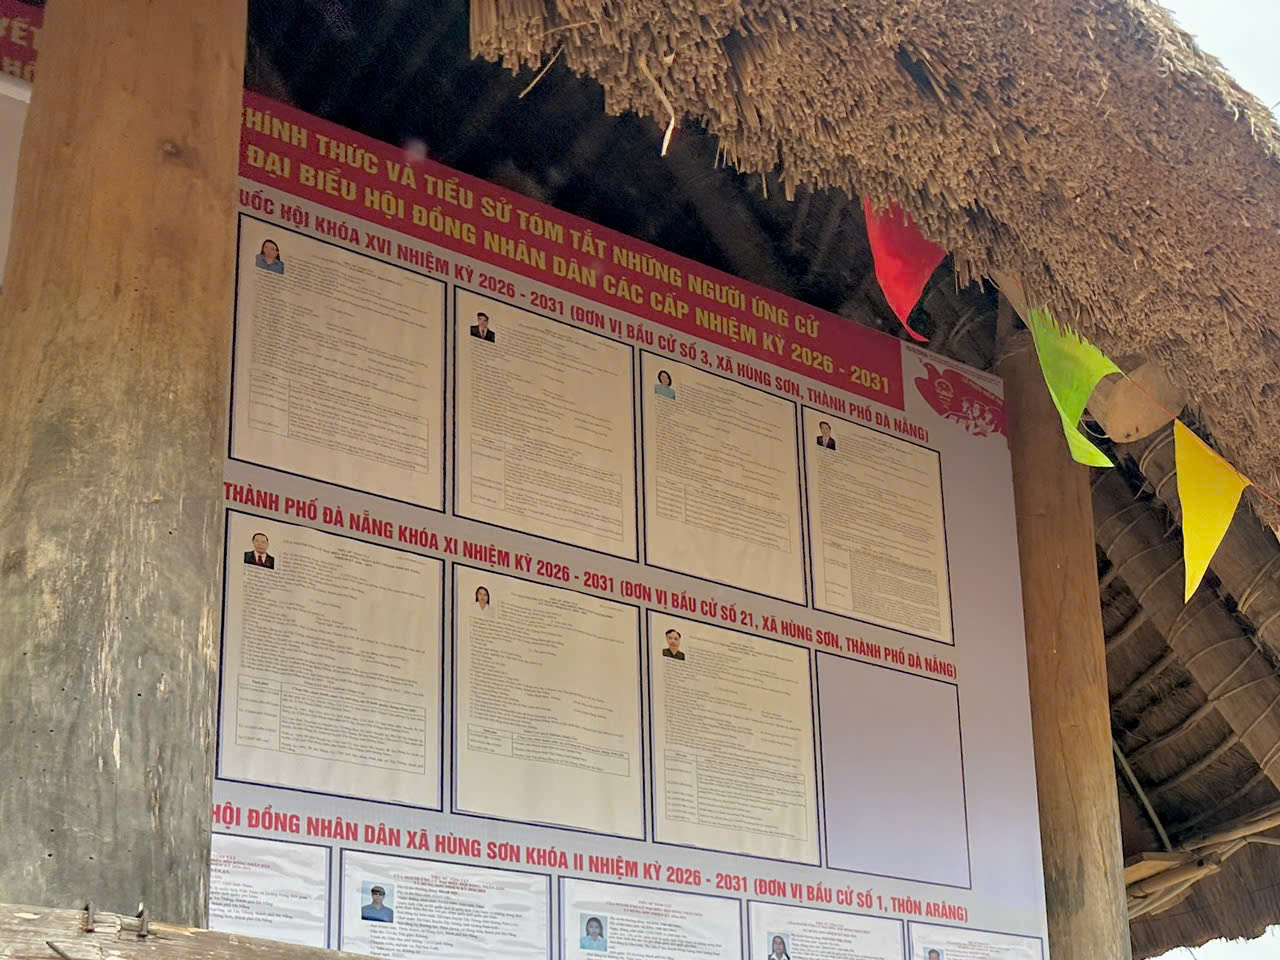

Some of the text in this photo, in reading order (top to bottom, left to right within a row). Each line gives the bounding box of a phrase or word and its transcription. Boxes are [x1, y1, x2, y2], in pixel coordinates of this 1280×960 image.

[240, 188, 274, 215] UỐC
[281, 203, 309, 229] HỘI
[315, 215, 360, 245] KHÓA
[366, 233, 391, 256] XVI
[398, 244, 449, 276] NHIỆM
[454, 264, 474, 284] KỲ
[479, 272, 515, 298] 2026
[530, 291, 564, 315] 2031
[680, 341, 697, 361] SỐ
[701, 350, 712, 368] 3,
[717, 354, 733, 374] XÃ
[737, 361, 771, 387] HÙNG
[807, 388, 846, 414] THÀNH
[876, 412, 890, 429] ĐÀ
[245, 107, 819, 338] HÍNH THỨC VÀ TIỂU SỬ TÓM TẮT NHỮNG NGƯỜI ỨNG CỬ
[247, 144, 291, 178] ĐẠI
[300, 163, 356, 201] BIỂU
[365, 187, 404, 219] HỘI
[412, 204, 477, 245] ĐỒNG
[484, 230, 546, 271] NHÂN
[553, 256, 597, 288] DÂN
[603, 275, 643, 304] CÁC
[650, 291, 689, 319] CẤP
[695, 308, 757, 346] NHIỆM
[763, 332, 786, 355] KỲ
[791, 344, 833, 374] 2026
[851, 365, 889, 394] 2031
[224, 482, 279, 512] THÀNH
[285, 496, 318, 521] PHỐ
[323, 506, 344, 528] ĐÀ
[350, 509, 393, 539] NẴNG
[399, 524, 439, 550] KHÓA
[443, 536, 458, 555] XI
[463, 541, 510, 568] NHIỆM
[515, 553, 532, 573] KỲ
[537, 560, 570, 582] 2026
[584, 571, 614, 593] 2031
[656, 589, 668, 609] VỊ
[700, 600, 718, 621] CỬ
[720, 603, 737, 623] SỐ
[740, 611, 759, 630] 21,
[762, 614, 778, 634] XÃ
[781, 619, 813, 642] HÙNG
[845, 637, 881, 660] THÀNH
[884, 647, 905, 665] PHỐ
[908, 652, 922, 670] ĐÀ
[212, 801, 241, 830] HỘI
[247, 804, 300, 835] ĐỒNG
[306, 816, 358, 842] NHÂN
[364, 823, 402, 847] DÂN
[406, 828, 430, 851] XÃ
[435, 832, 482, 858] HÙNG
[487, 841, 520, 863] SƠN
[526, 846, 569, 871] KHÓA
[573, 853, 584, 872] II
[589, 855, 638, 881] NHIỆM
[643, 860, 662, 881] KỲ
[667, 866, 702, 886] 2026
[716, 872, 748, 893] 2031
[790, 883, 803, 904] VỊ
[837, 884, 854, 907] CỬ
[857, 888, 873, 909] SỐ
[891, 896, 922, 916] THÔN
